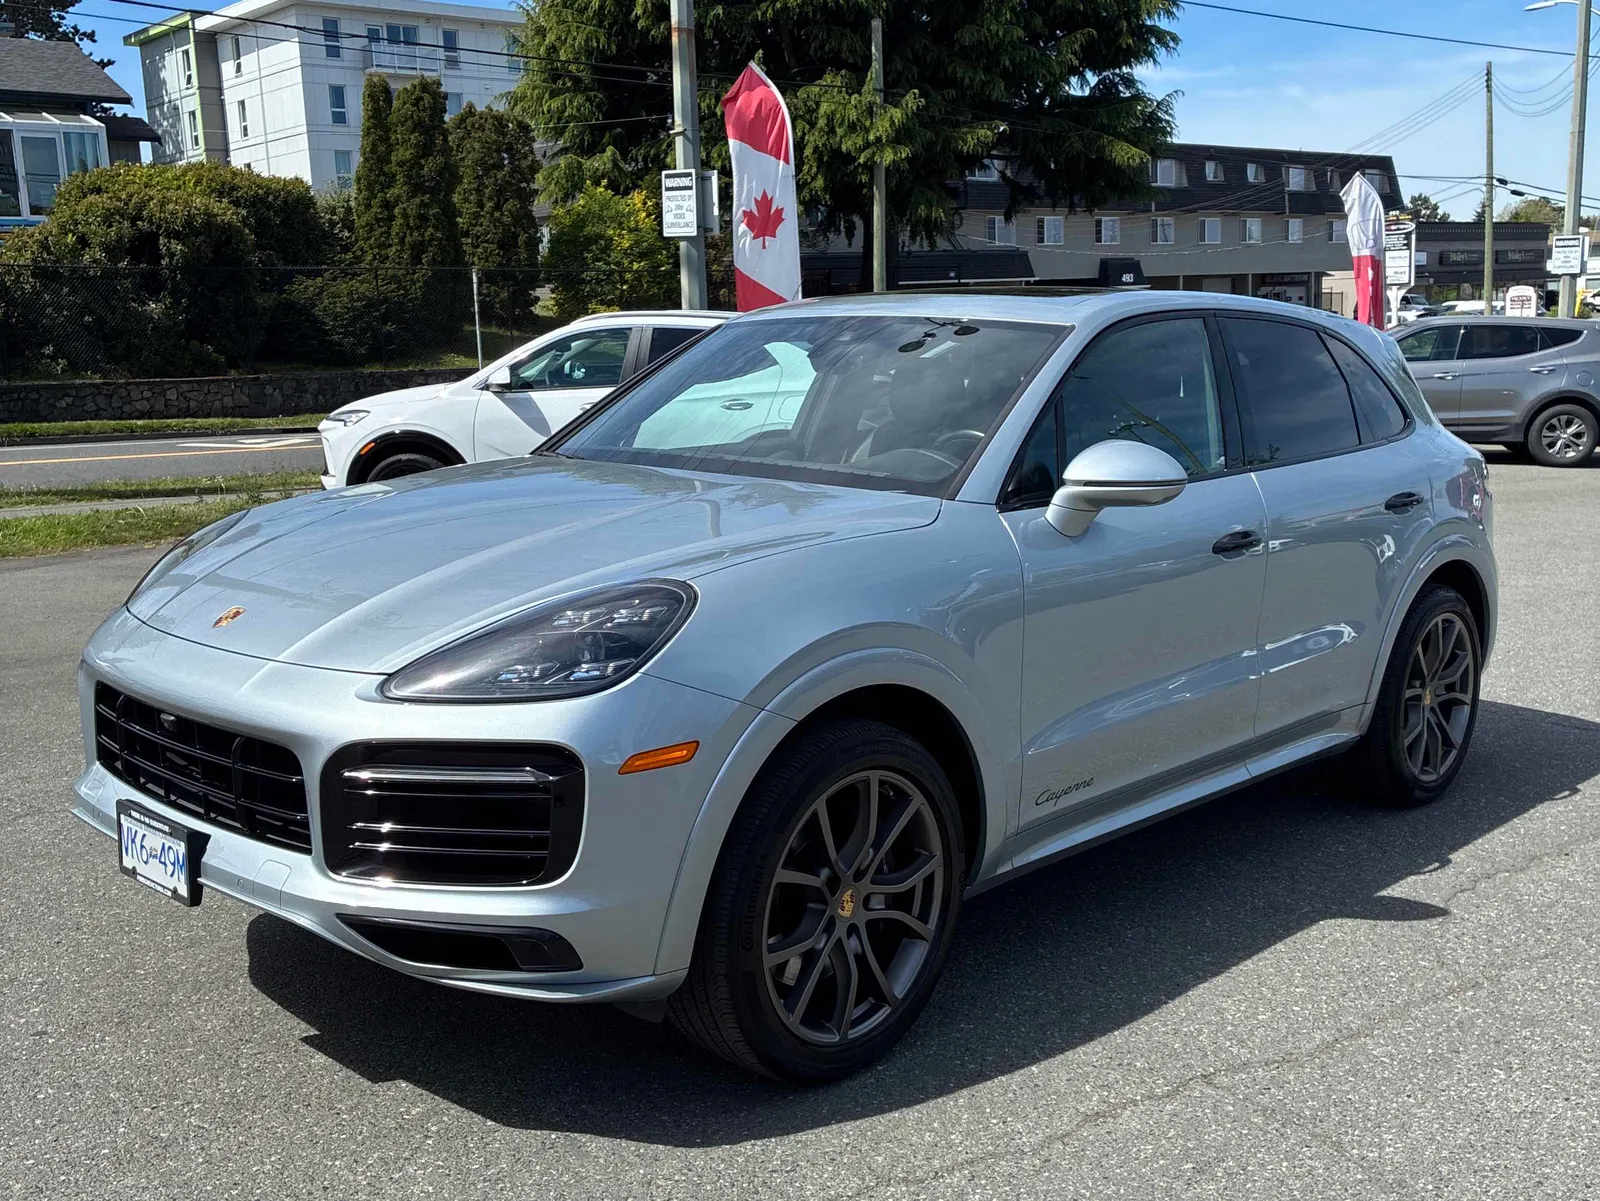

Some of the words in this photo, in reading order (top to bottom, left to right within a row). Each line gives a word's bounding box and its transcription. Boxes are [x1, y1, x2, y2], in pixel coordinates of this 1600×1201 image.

[665, 177, 693, 188] WARNING
[665, 221, 694, 229] SURVEILLANCE
[1555, 239, 1580, 247] WARNING
[1121, 273, 1134, 283] 493
[1035, 777, 1095, 807] Cayenne
[158, 841, 187, 885] 49M
